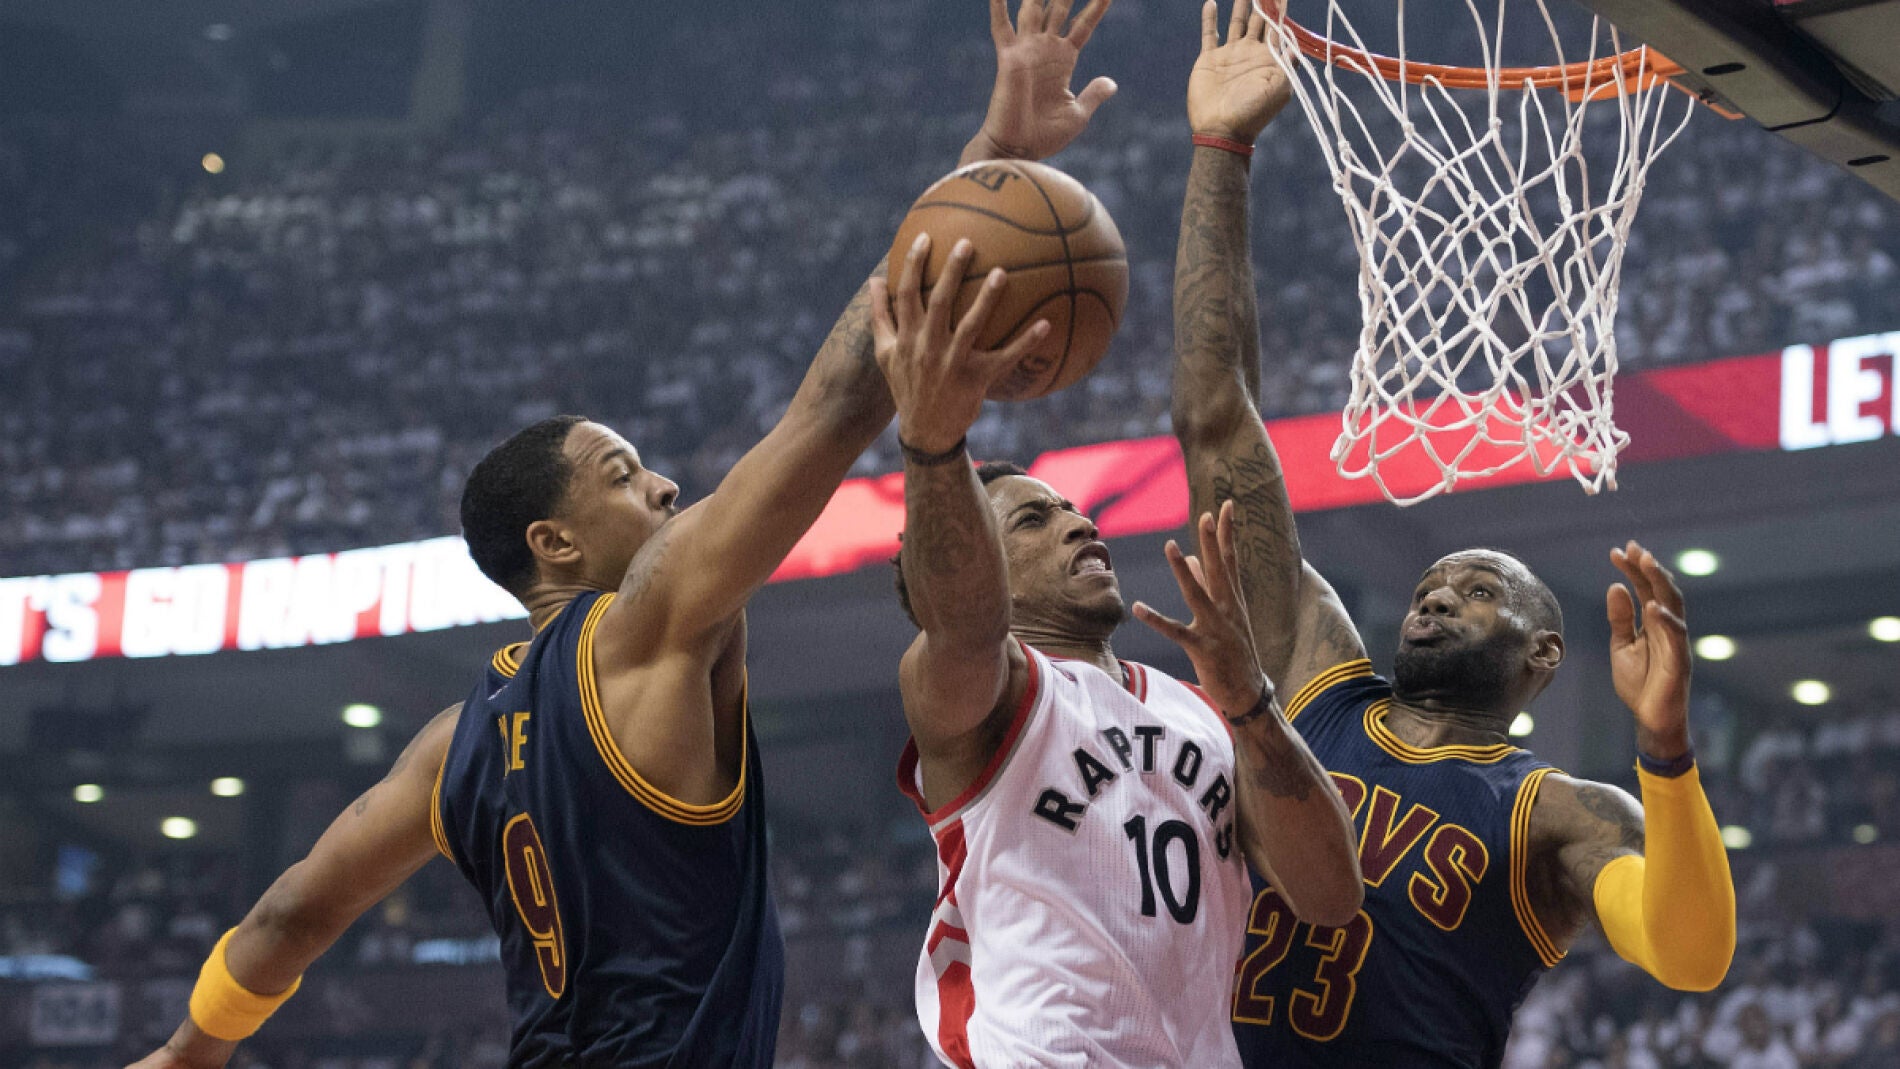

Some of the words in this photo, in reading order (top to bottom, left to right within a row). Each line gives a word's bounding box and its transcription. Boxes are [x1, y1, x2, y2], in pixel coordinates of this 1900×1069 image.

[121, 563, 230, 658] GO
[237, 535, 529, 651] RAPTO
[1033, 725, 1234, 861] RAPTORS
[1327, 770, 1490, 932] VS
[502, 811, 567, 1000] 9
[1123, 814, 1201, 925] 10
[1231, 886, 1374, 1043] 23
